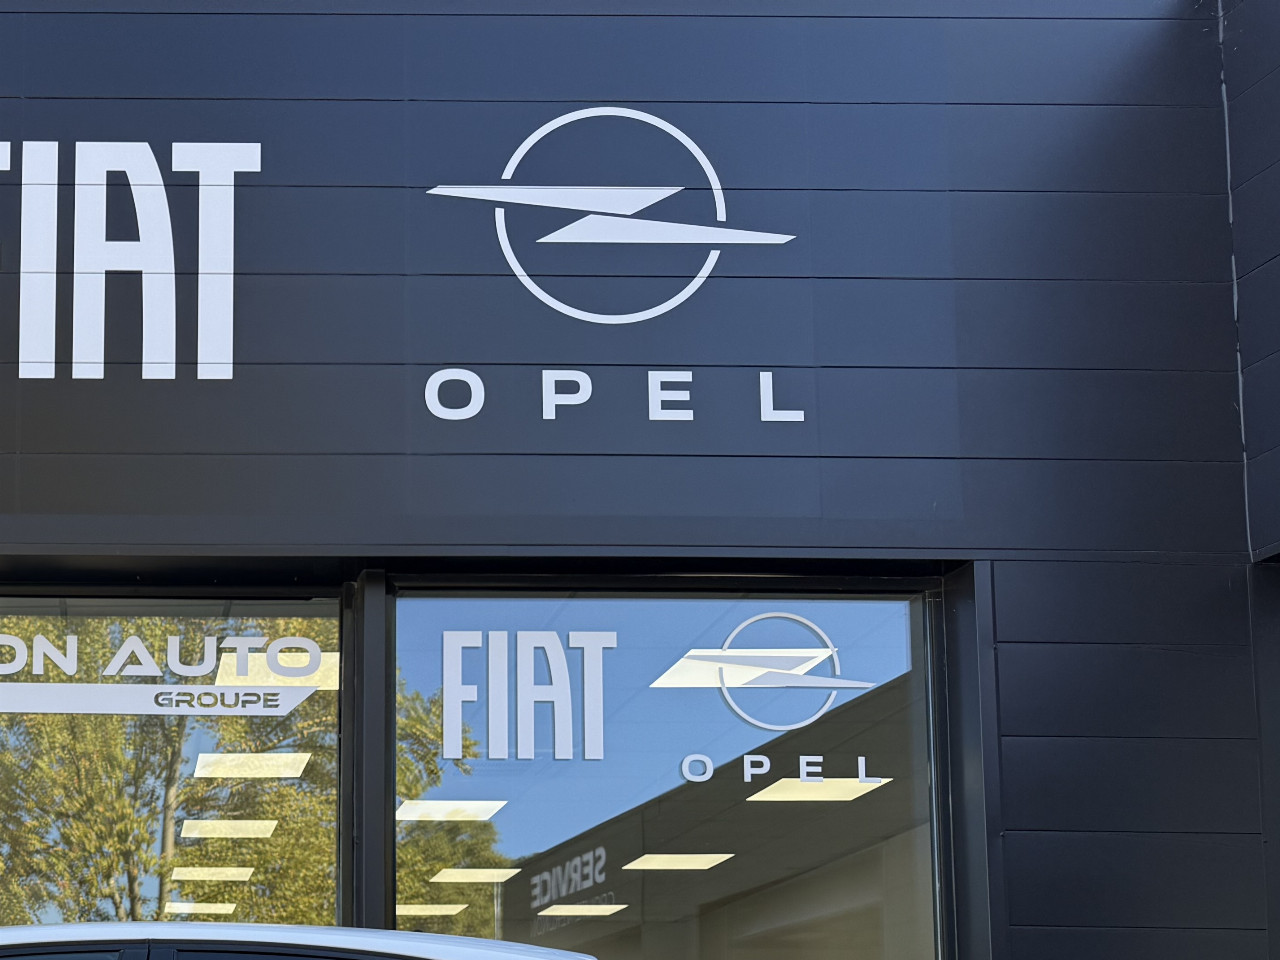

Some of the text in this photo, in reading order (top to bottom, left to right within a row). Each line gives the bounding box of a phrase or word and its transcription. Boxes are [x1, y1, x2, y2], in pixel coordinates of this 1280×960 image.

[424, 368, 806, 423] OPEL
[102, 634, 322, 678] AUTO
[153, 691, 281, 710] GROUPE
[442, 630, 618, 761] FIAT
[680, 753, 883, 784] OPEL
